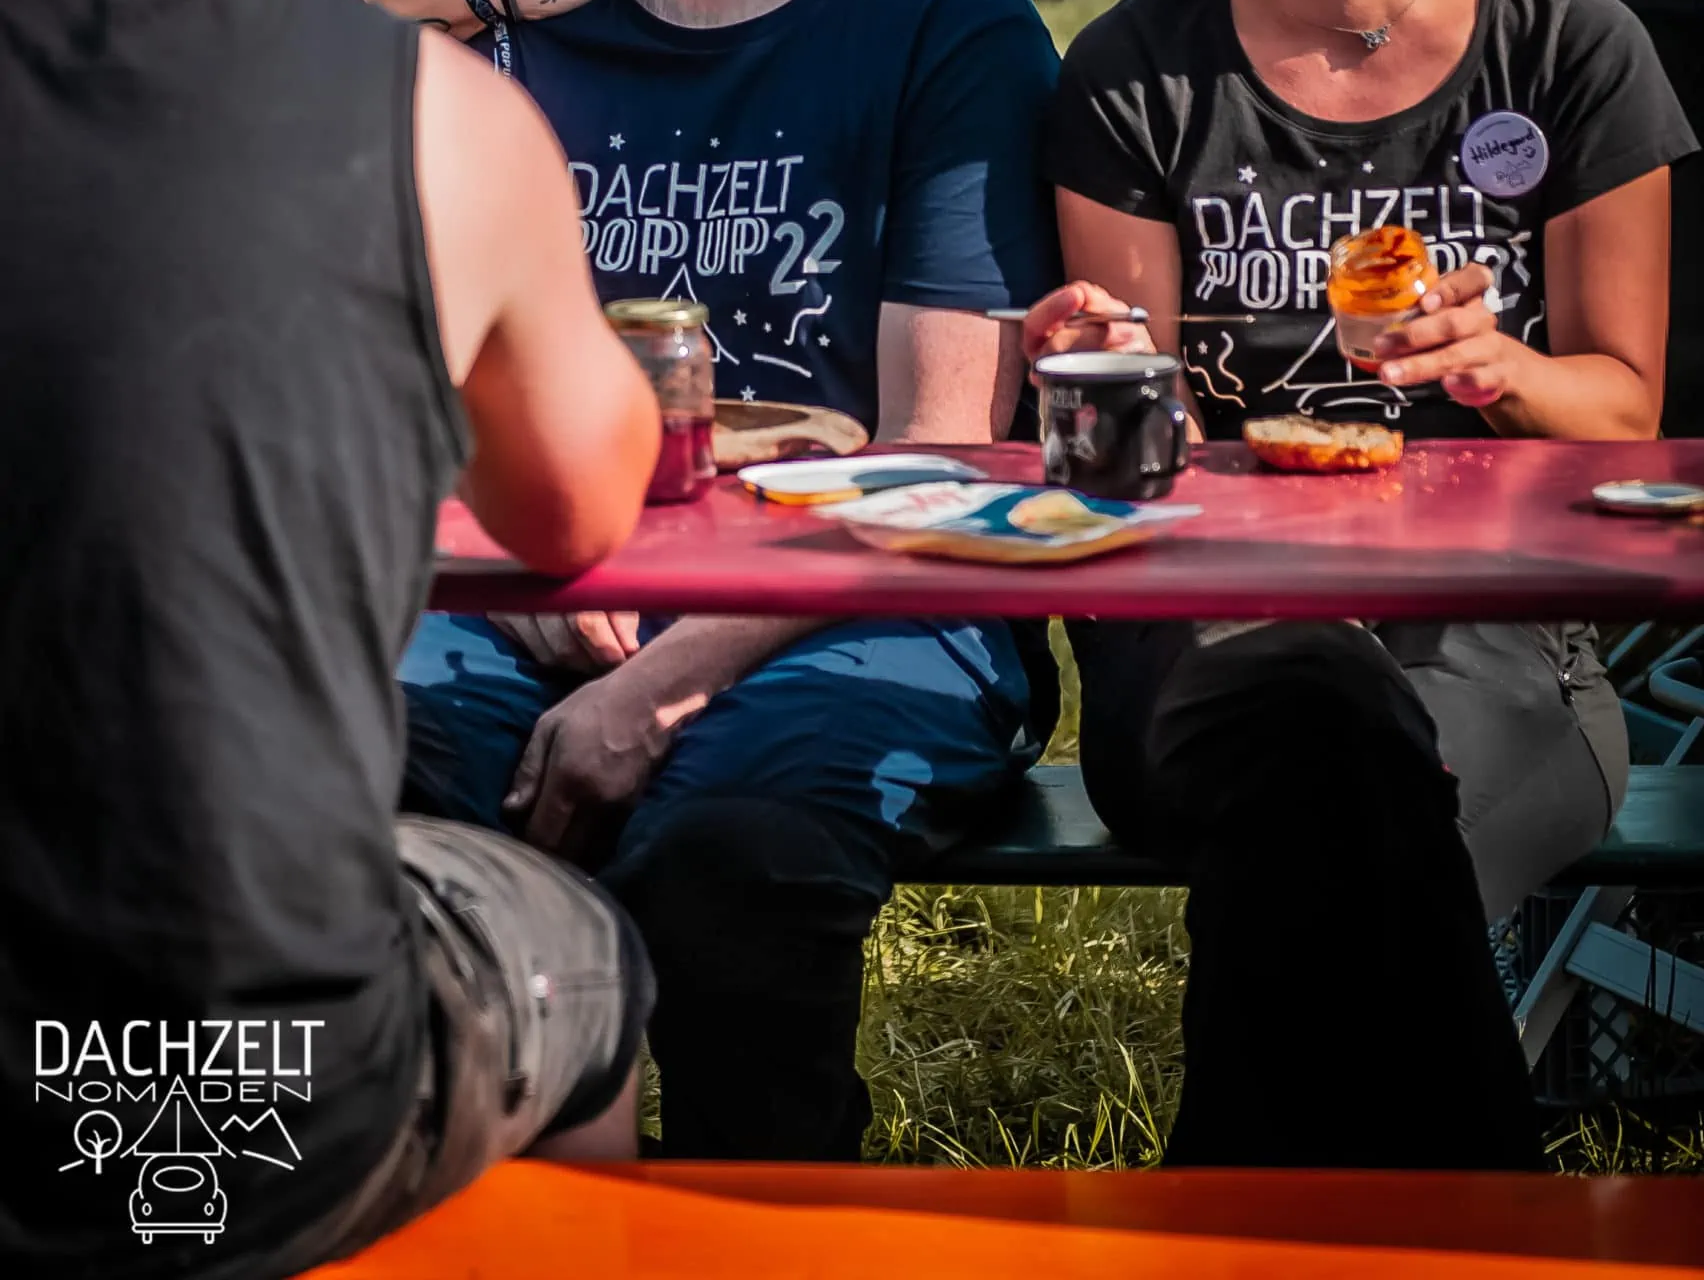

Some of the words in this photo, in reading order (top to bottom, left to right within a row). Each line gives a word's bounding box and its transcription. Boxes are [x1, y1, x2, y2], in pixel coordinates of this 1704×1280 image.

[567, 155, 804, 220] DACHZELT
[696, 217, 770, 277] UP
[769, 199, 846, 296] 22
